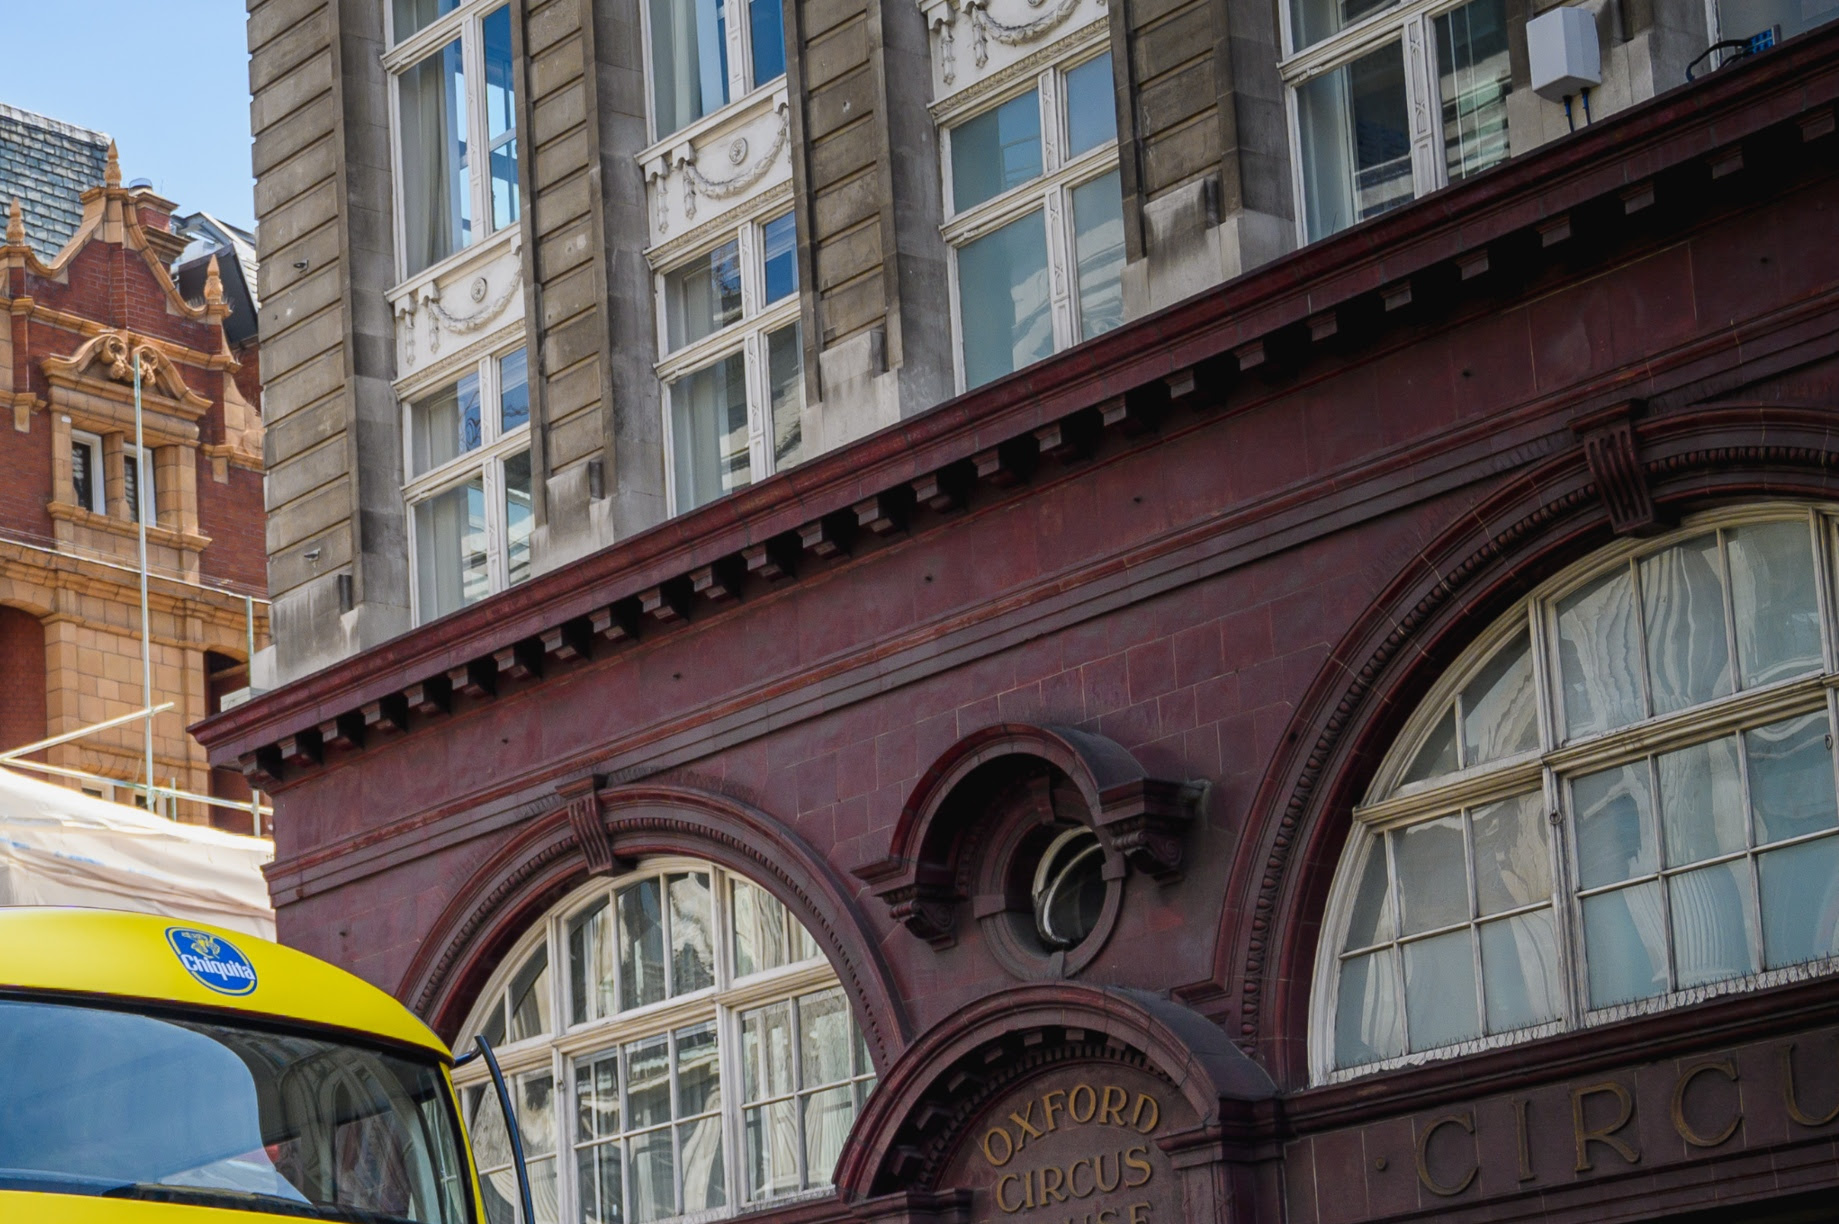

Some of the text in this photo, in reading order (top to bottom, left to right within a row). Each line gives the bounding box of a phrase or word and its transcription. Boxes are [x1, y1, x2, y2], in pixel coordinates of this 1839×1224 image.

[180, 954, 256, 981] Chiquita
[984, 1084, 1160, 1167] OXFORD
[996, 1145, 1153, 1214] CIRCUS
